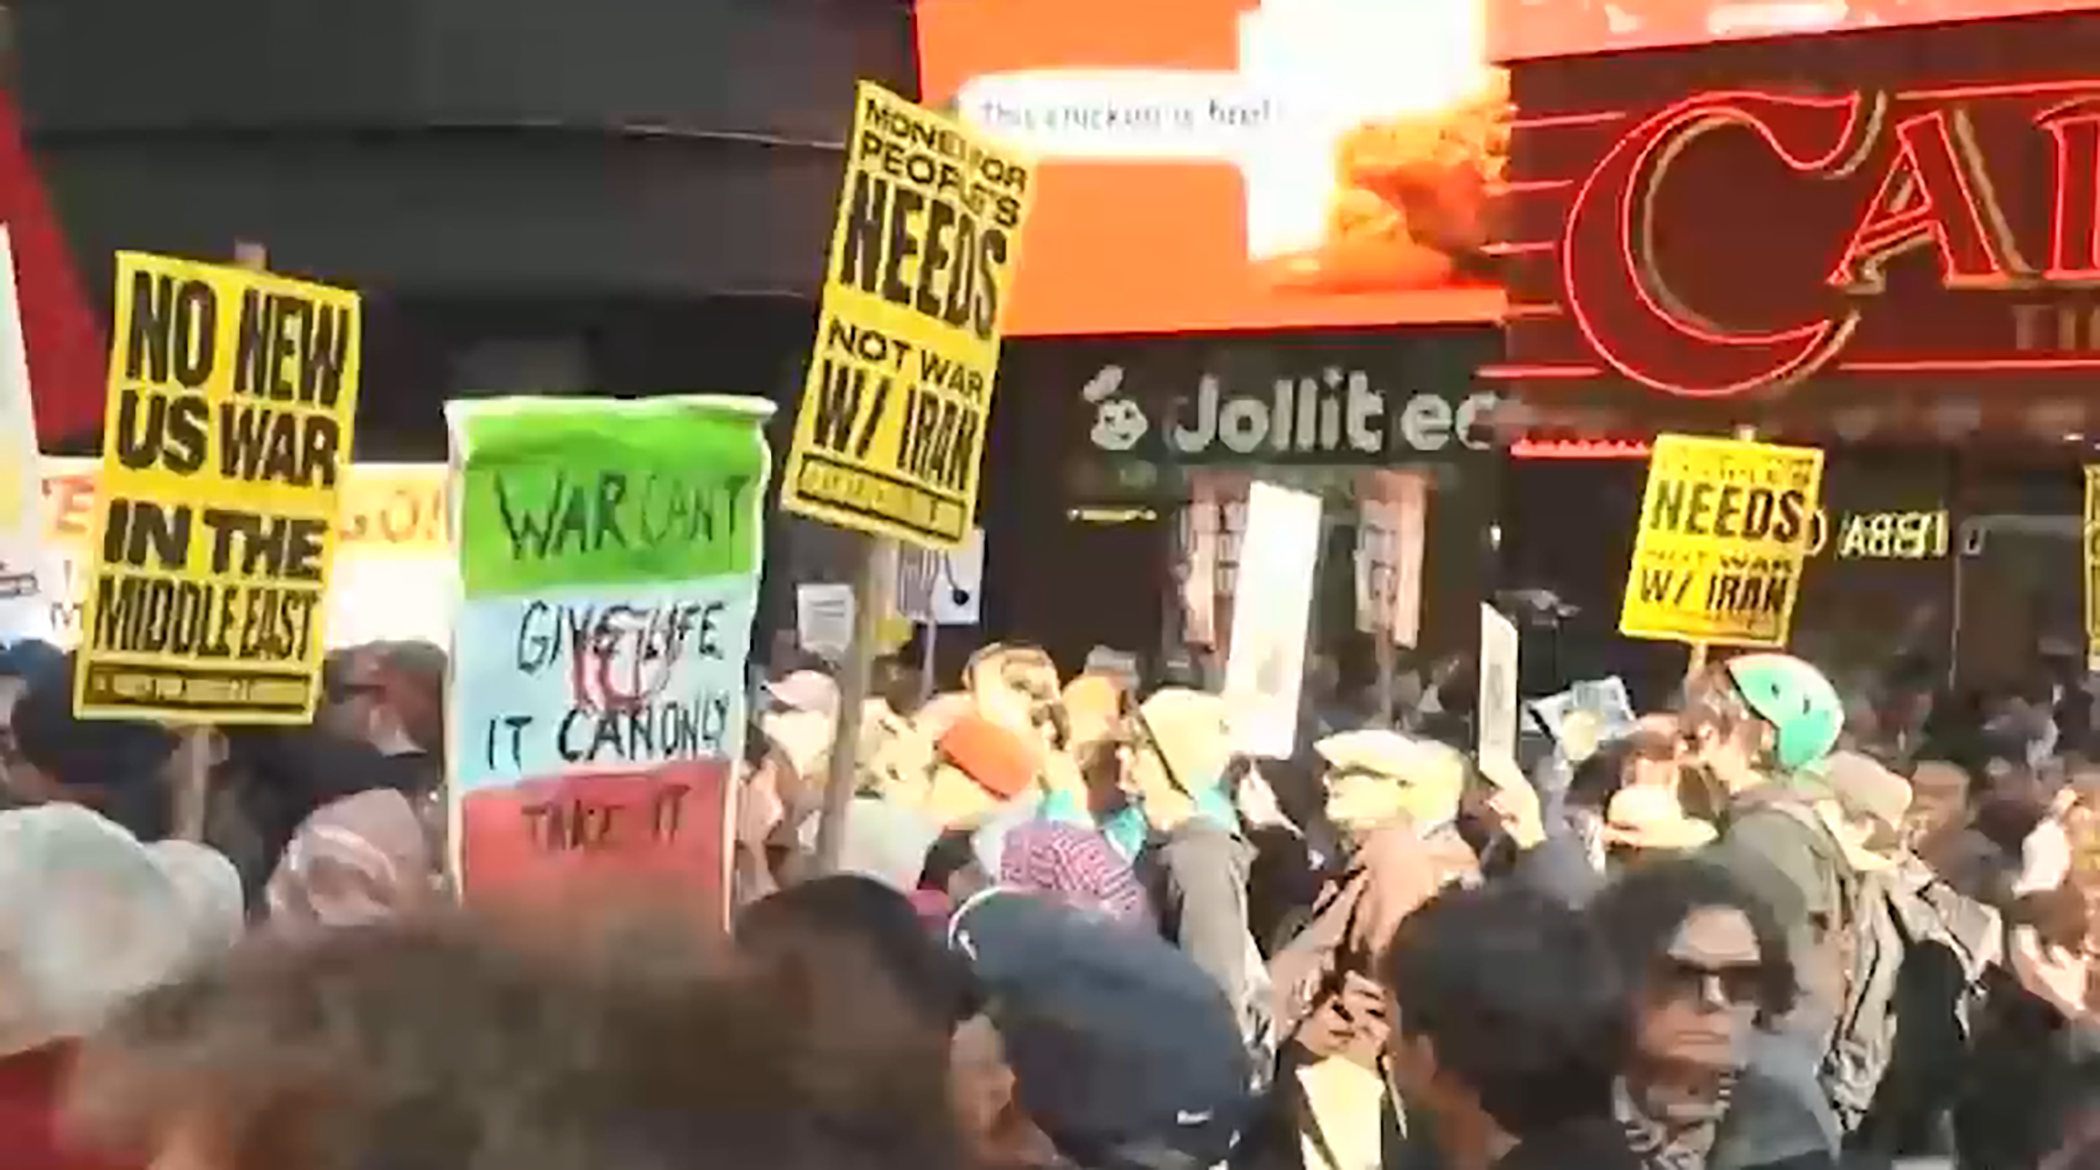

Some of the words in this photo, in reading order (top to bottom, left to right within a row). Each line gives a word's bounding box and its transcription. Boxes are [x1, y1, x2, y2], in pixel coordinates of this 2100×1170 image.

[840, 170, 1007, 340] NEEDS
[124, 270, 218, 387] NO
[234, 289, 350, 407] NEW
[827, 316, 912, 372] NOT
[920, 349, 984, 405] WAR
[117, 388, 208, 476] US
[219, 402, 341, 488] WAR
[813, 358, 890, 462] W/
[896, 383, 979, 491] IRAN
[103, 497, 192, 570] IN
[203, 508, 329, 580] THE
[494, 470, 627, 560] WAR
[1649, 478, 1804, 544] NEEDS
[94, 578, 238, 657] MIDDLE
[240, 585, 323, 662] EAST
[1641, 569, 1694, 605] W/
[1705, 574, 1789, 613] IRAN
[517, 600, 626, 673] GIVE
[488, 714, 534, 771] IT
[556, 705, 653, 763] CAN
[660, 690, 730, 762] ONLY
